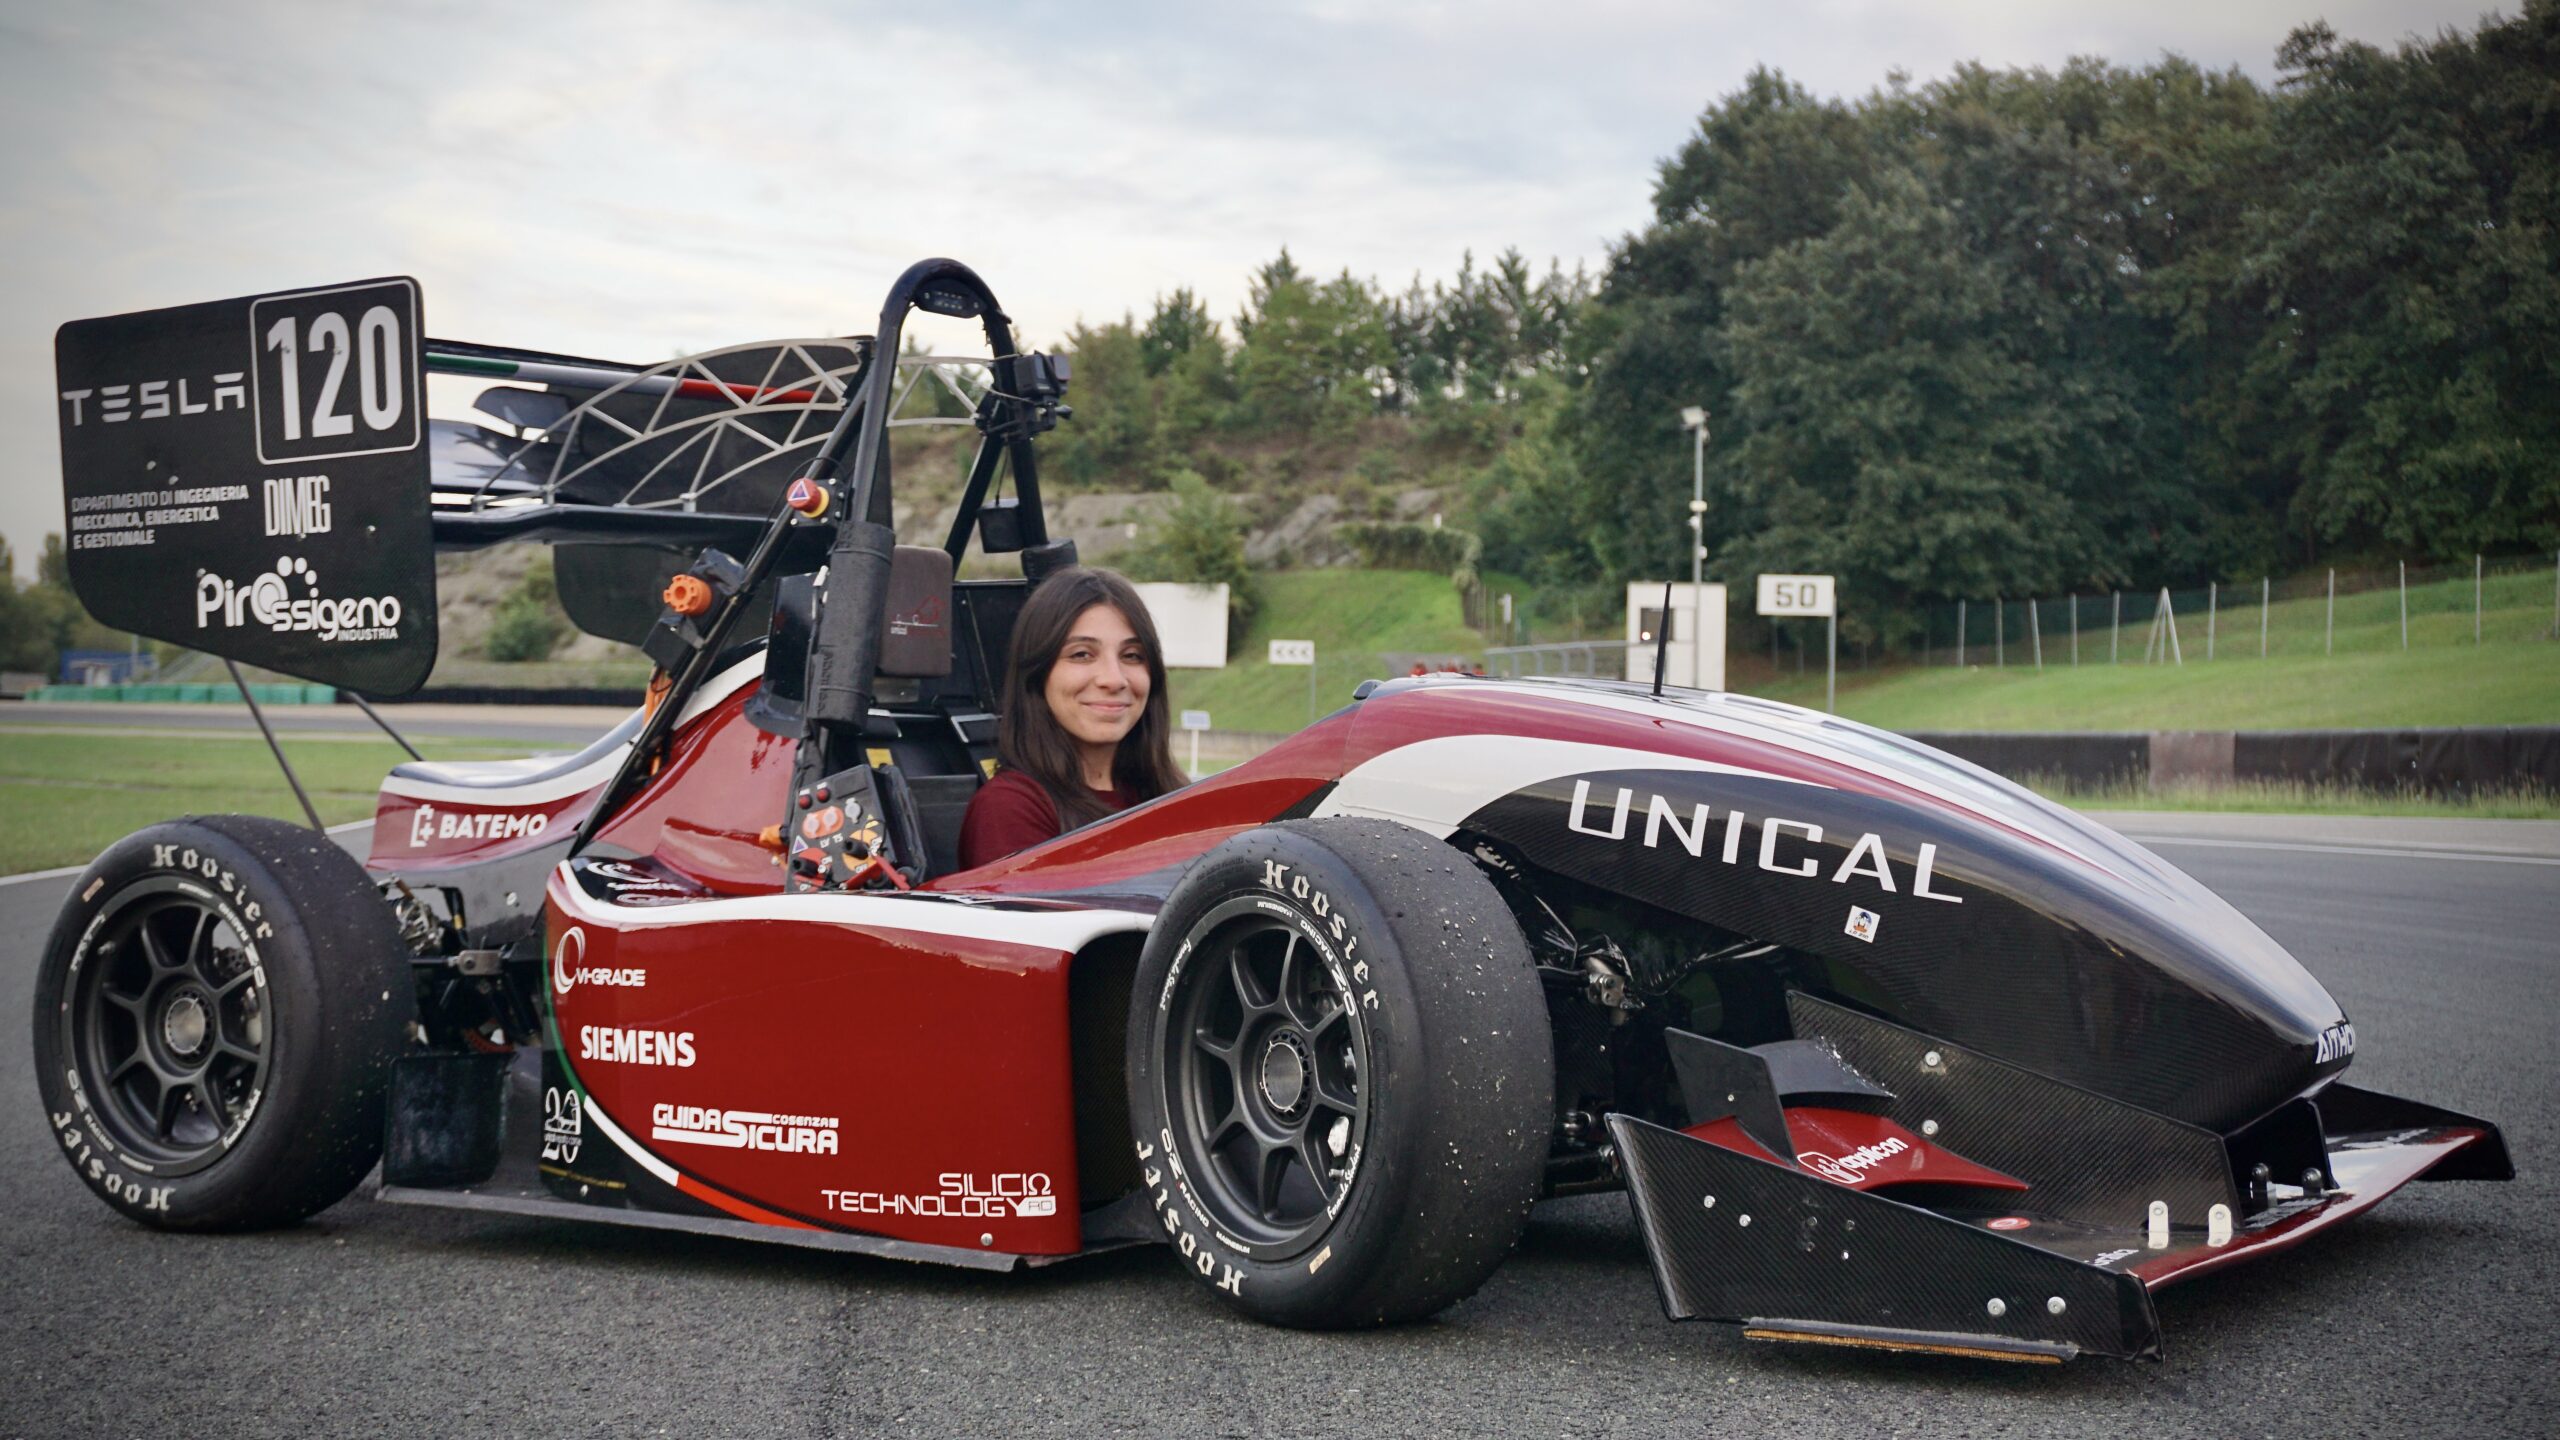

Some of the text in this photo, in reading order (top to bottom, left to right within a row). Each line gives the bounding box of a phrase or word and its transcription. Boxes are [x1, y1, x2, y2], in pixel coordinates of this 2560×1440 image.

[267, 305, 403, 441] 120
[61, 372, 246, 426] TESLA
[72, 484, 249, 513] DIPARTIMENTO DI INGEGNERIA
[264, 475, 332, 537] DIMEG
[72, 506, 220, 531] MECCANICA, ENERGETICA
[73, 529, 156, 550] E GESTIONALE
[1775, 583, 1817, 608] 50
[338, 627, 399, 642] INDUSTRIA
[439, 813, 549, 839] BATEMO
[1568, 779, 1963, 904] UNICAL
[1300, 919, 1334, 962] RACING
[580, 1025, 697, 1068] SIEMENS
[1838, 1137, 1909, 1169] applicon
[821, 1189, 1027, 1218] TECHNOLOGY
[1179, 1182, 1209, 1228] RACING
